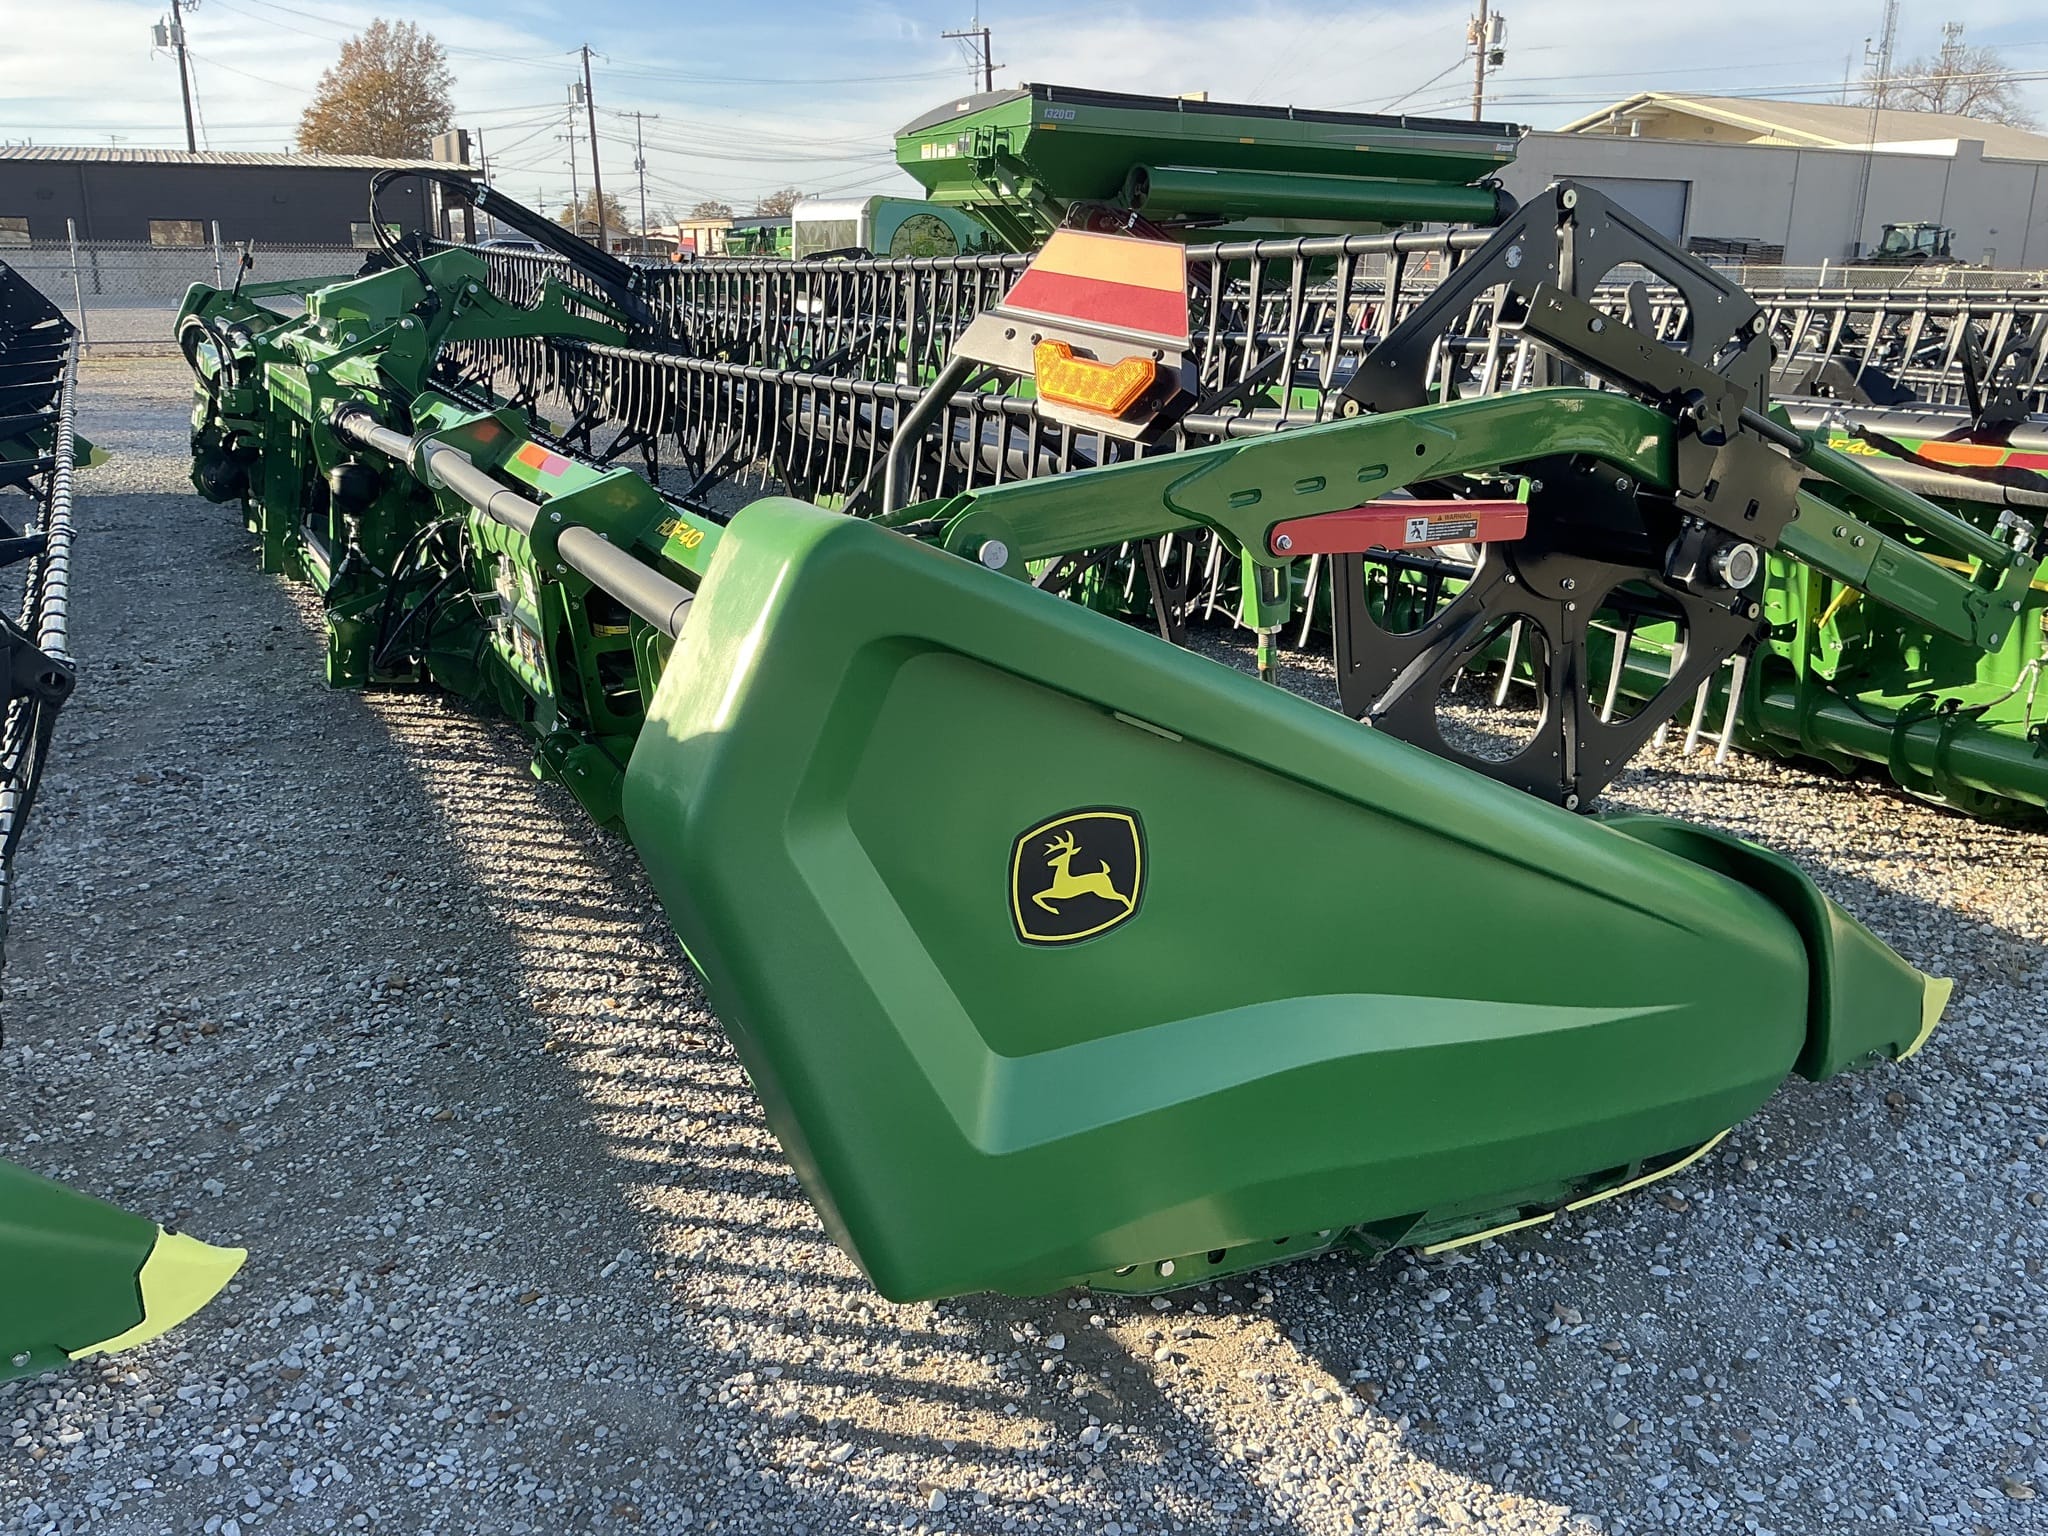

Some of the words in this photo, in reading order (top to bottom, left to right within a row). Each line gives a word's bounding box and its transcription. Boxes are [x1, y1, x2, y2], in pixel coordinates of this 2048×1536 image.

[1643, 347, 1654, 361] 2
[1444, 512, 1472, 521] WARNING
[655, 516, 705, 549] HDF40
